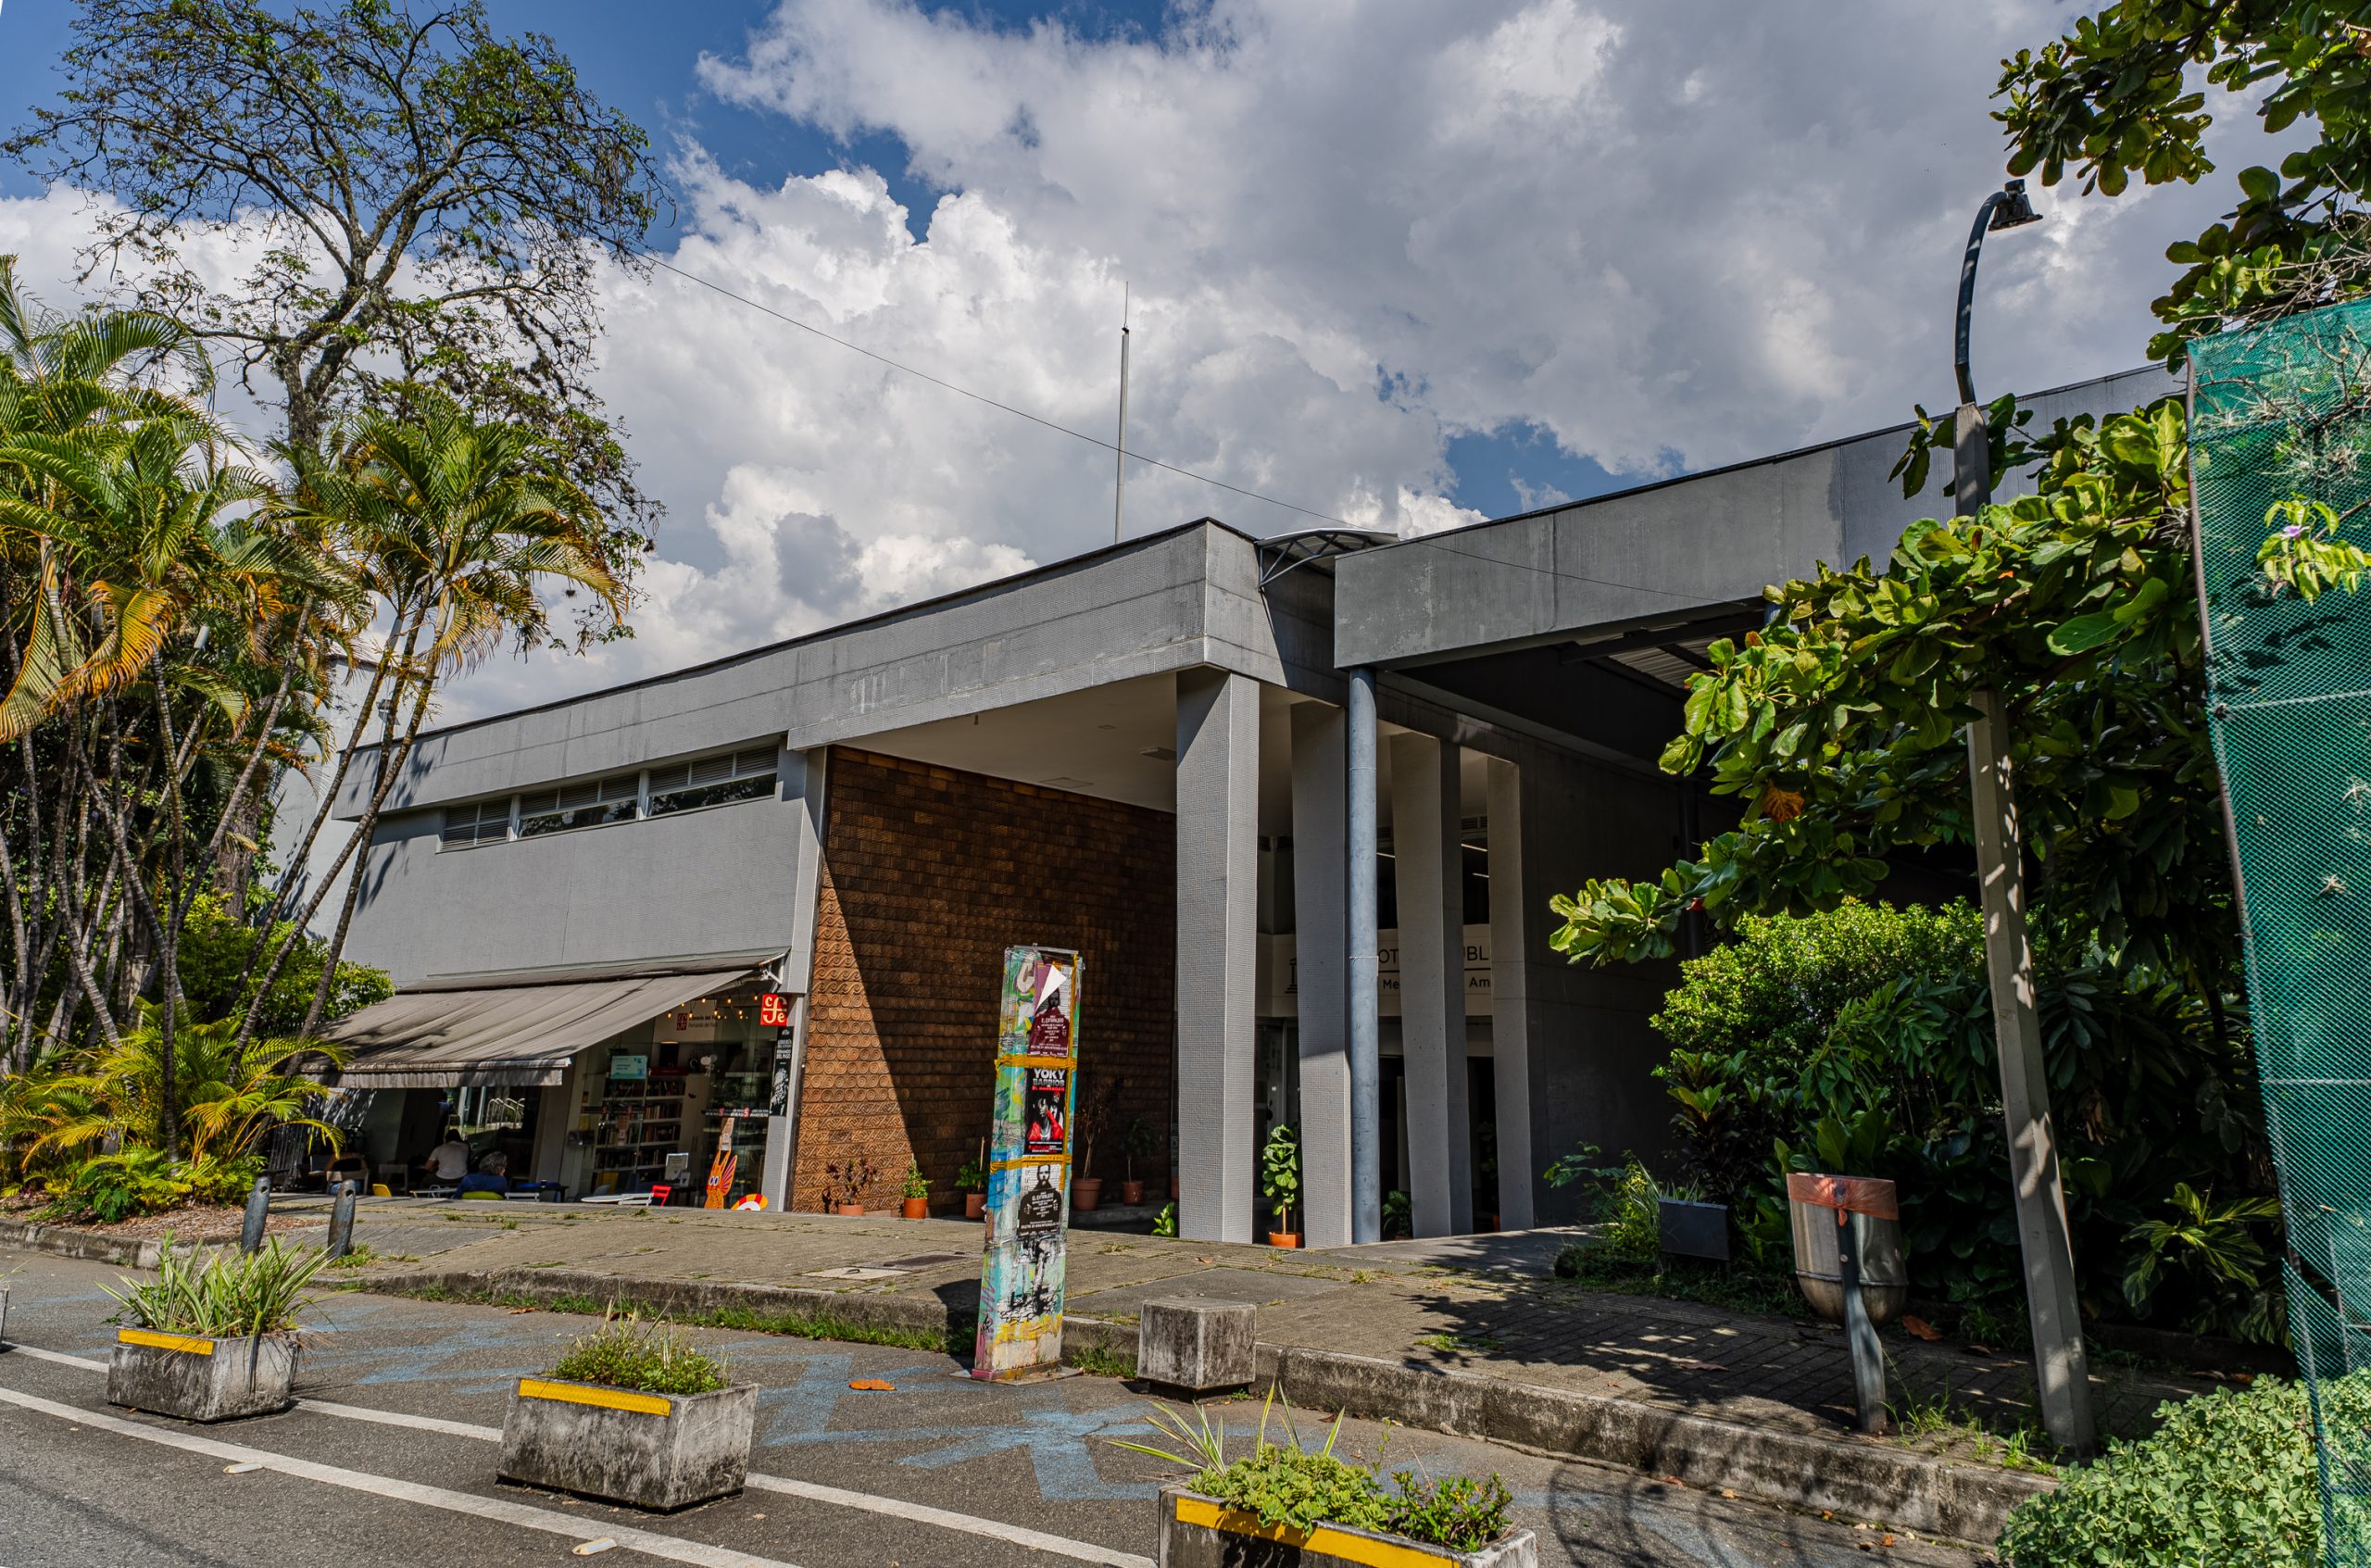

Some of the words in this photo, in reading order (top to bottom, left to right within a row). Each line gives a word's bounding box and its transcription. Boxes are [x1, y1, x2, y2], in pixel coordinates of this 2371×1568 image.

[1377, 948, 1399, 963] OT
[1466, 946, 1489, 961] BL
[1383, 979, 1400, 990] Me
[1469, 977, 1490, 987] Am
[1034, 1068, 1065, 1080] YOKY
